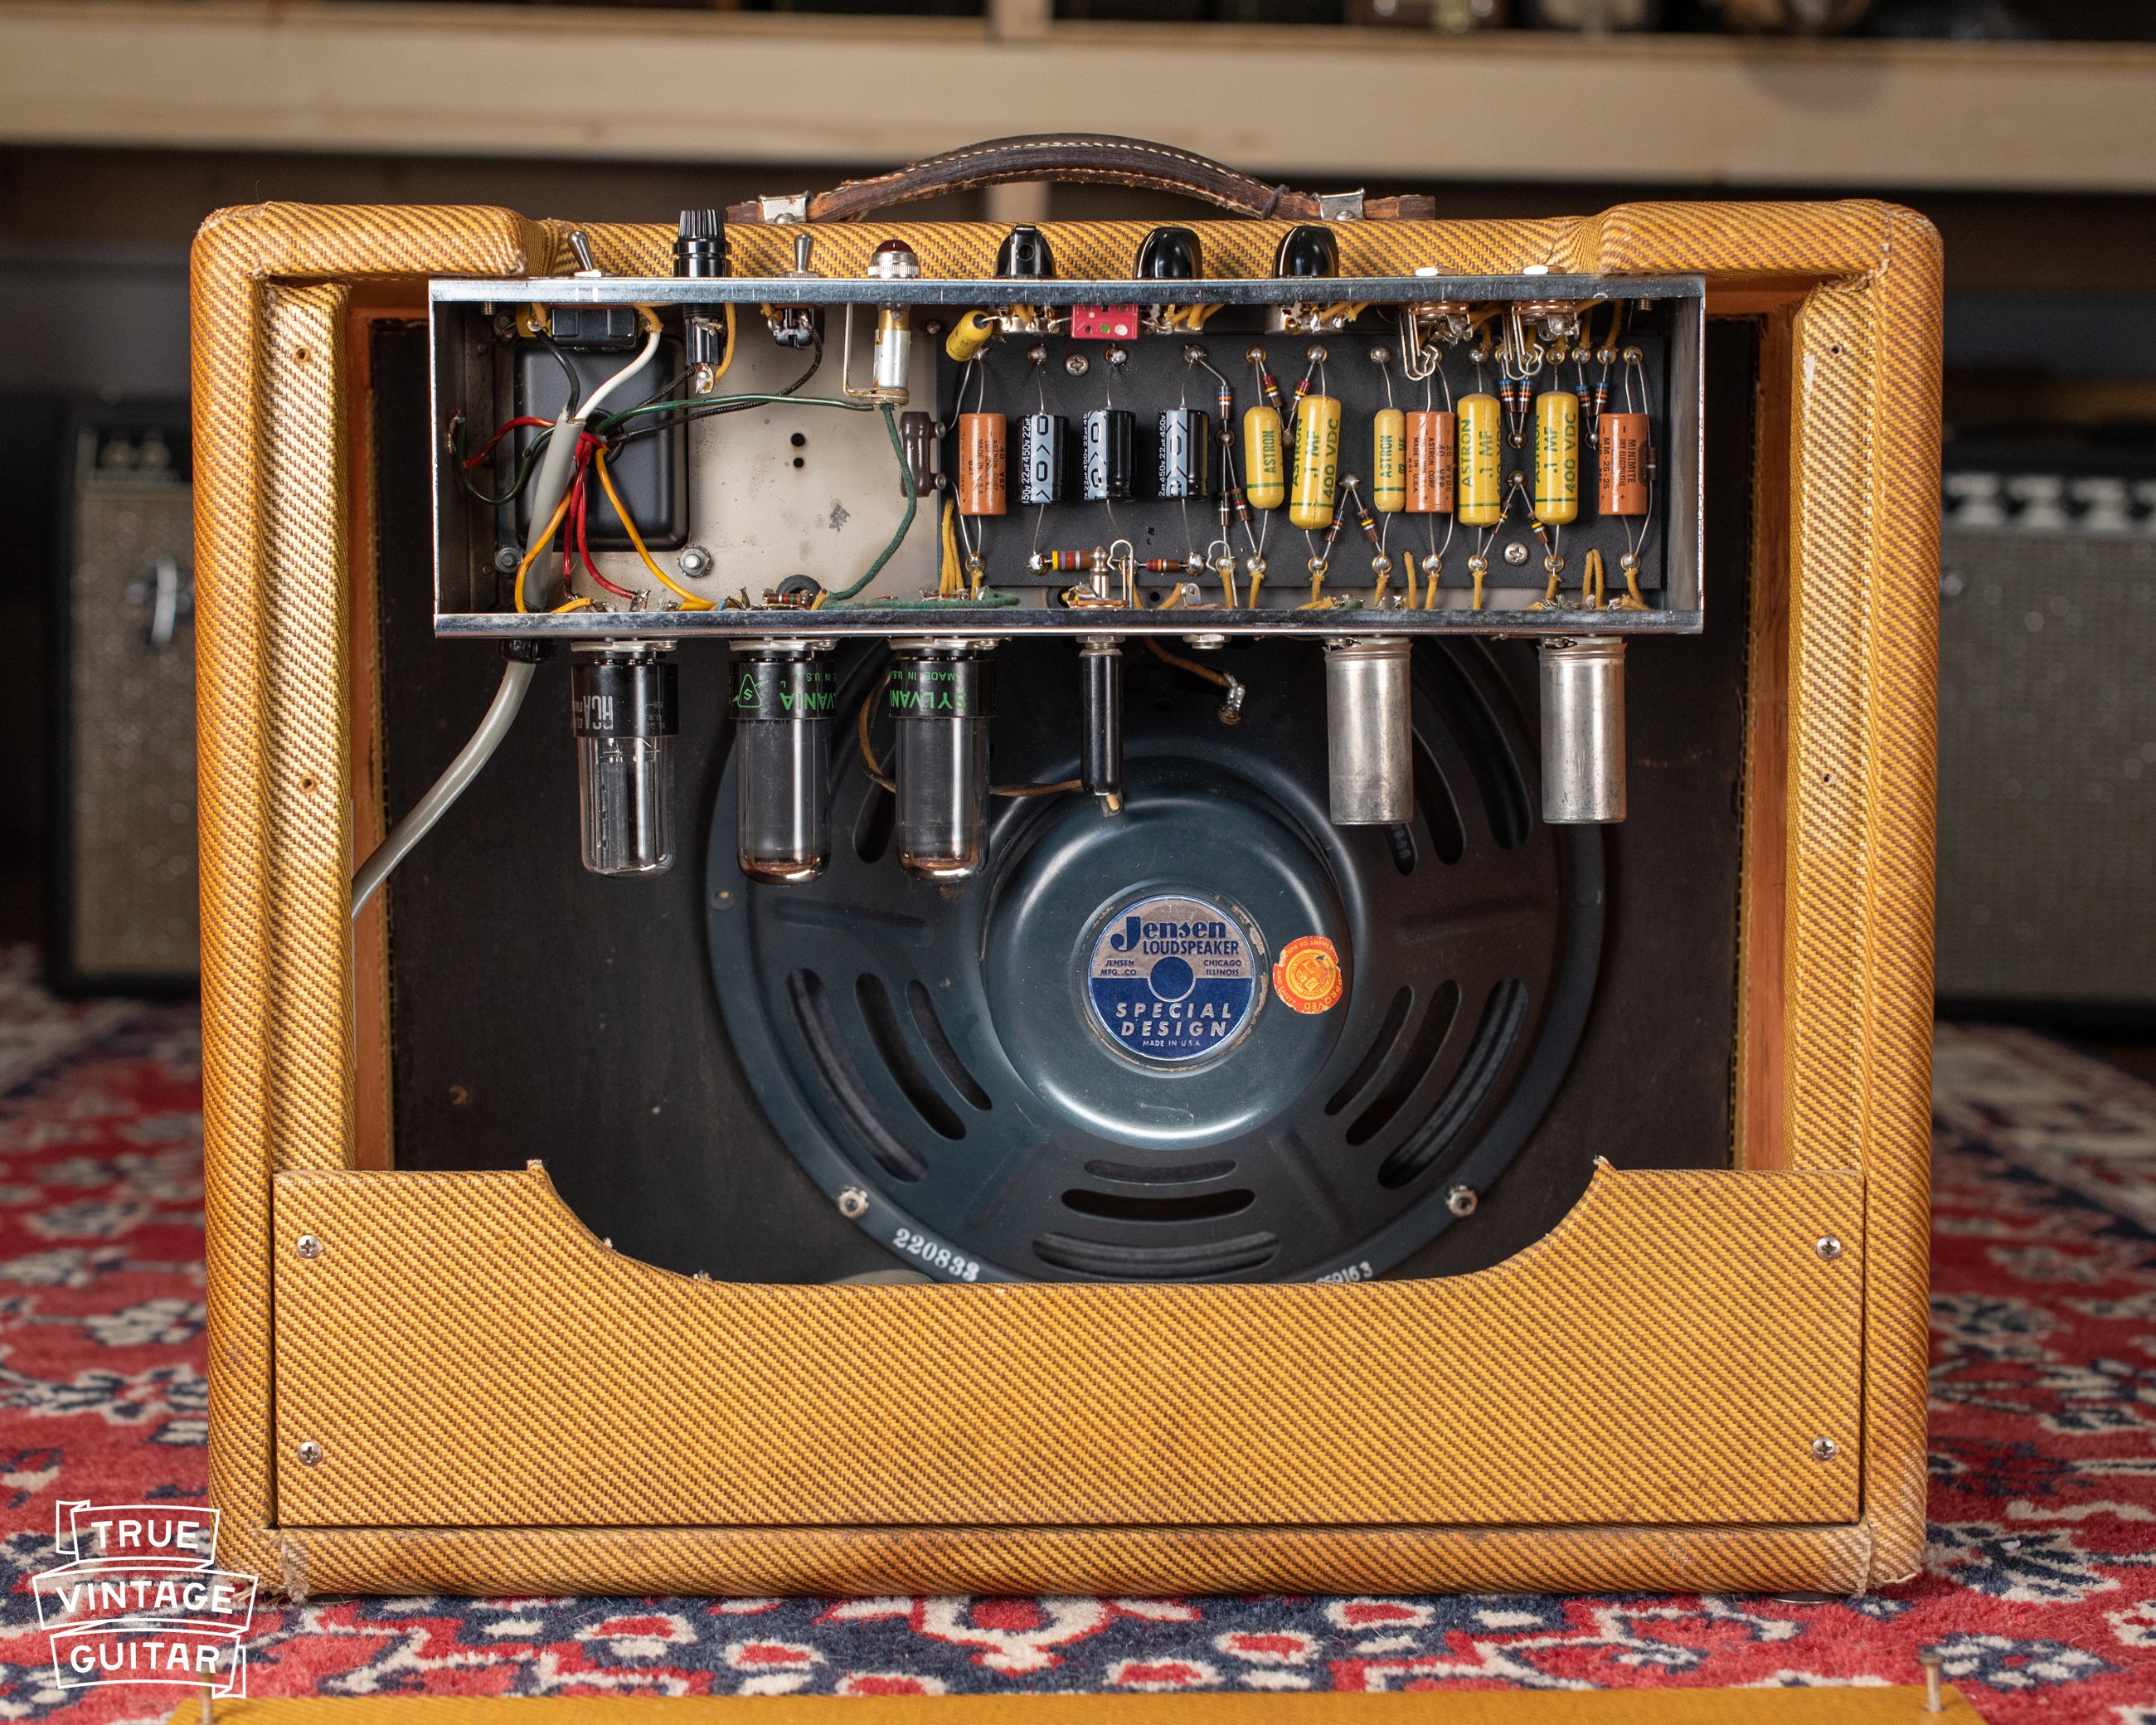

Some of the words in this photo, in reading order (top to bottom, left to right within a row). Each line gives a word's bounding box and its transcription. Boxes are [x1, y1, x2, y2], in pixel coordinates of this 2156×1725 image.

[1305, 430, 1320, 457] MF
[1326, 418, 1338, 457] VDC
[1479, 430, 1493, 457] MF
[1544, 426, 1557, 452] MF
[1565, 413, 1576, 452] VDC
[1262, 430, 1276, 474] ASTRON
[1380, 435, 1392, 478] ASTRON
[1461, 419, 1473, 487] ASTRON
[1323, 464, 1335, 499] 400
[1564, 459, 1576, 493] 400
[908, 671, 916, 680] IN
[925, 672, 955, 681] MADE
[583, 695, 614, 730] RCA
[779, 692, 836, 711] VANIA
[1110, 916, 1226, 952] Jensen
[1143, 940, 1239, 955] LOUDSPEAKER
[1115, 1003, 1231, 1018] SPECIAL
[1121, 1021, 1227, 1037] DESIGN
